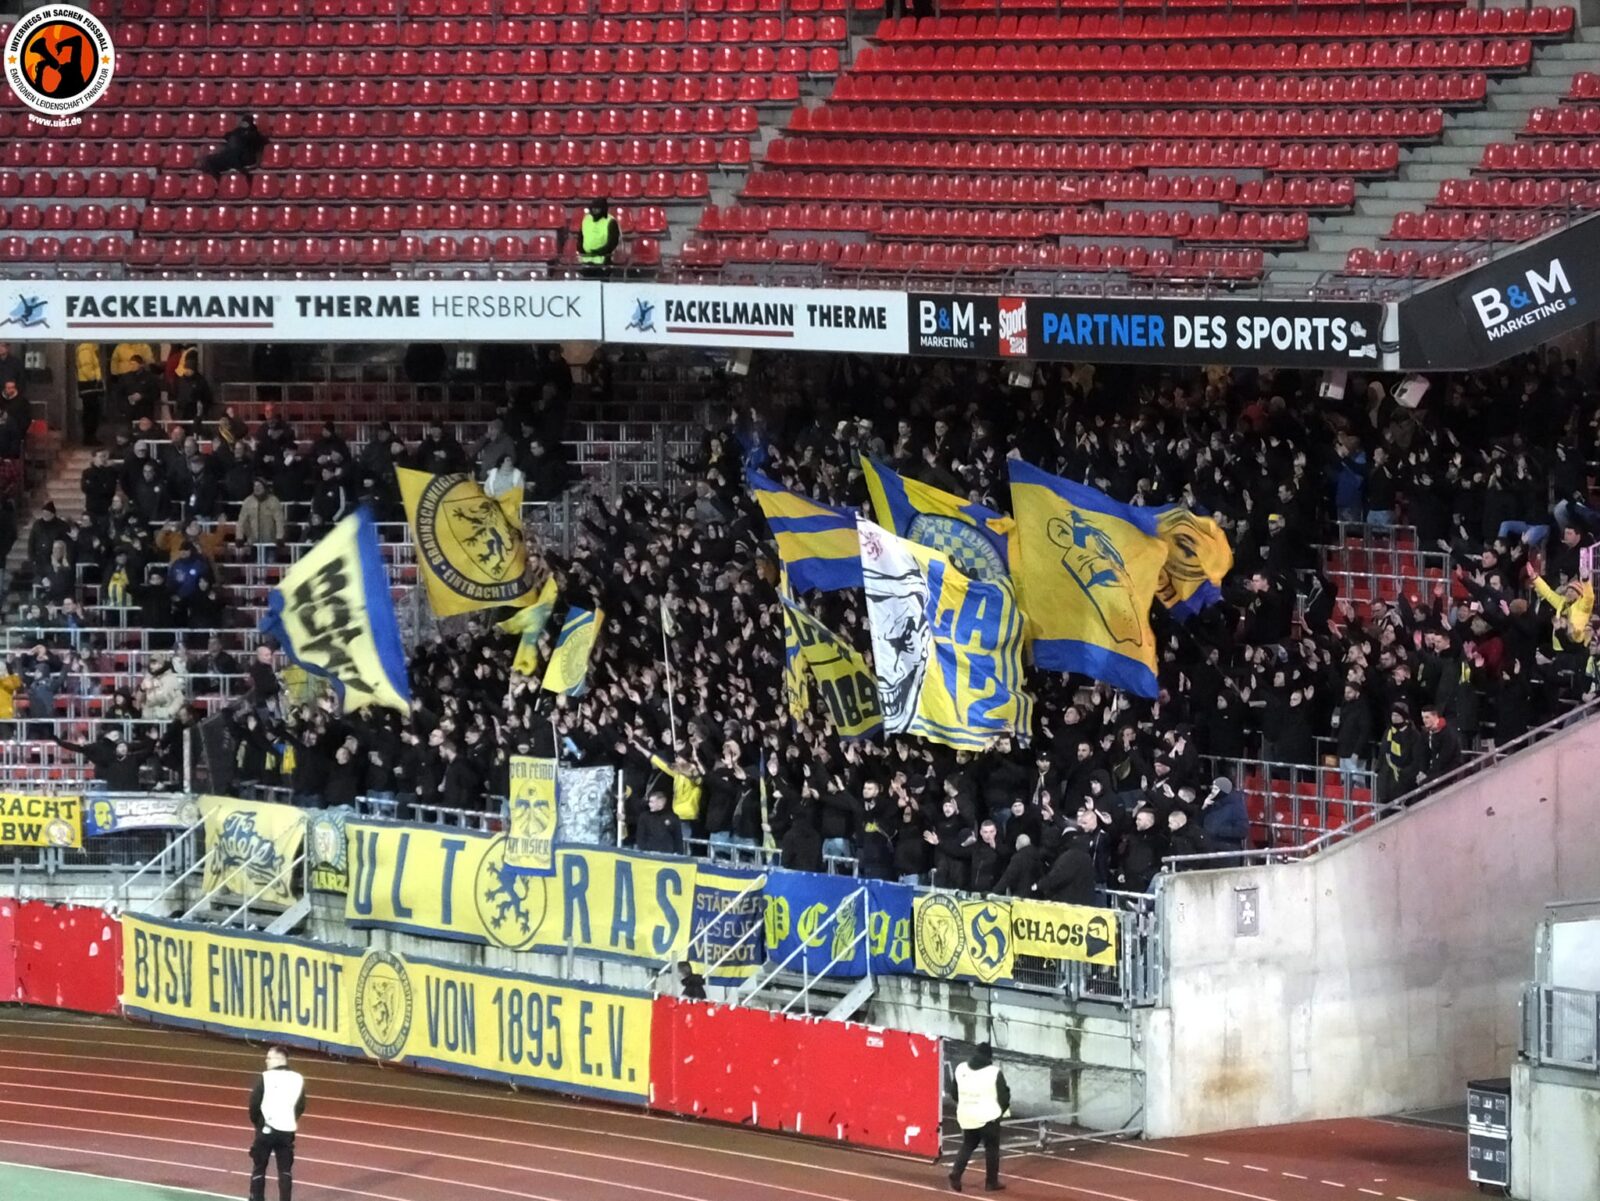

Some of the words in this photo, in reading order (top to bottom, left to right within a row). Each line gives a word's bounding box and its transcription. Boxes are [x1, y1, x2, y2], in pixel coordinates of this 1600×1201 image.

[66, 295, 275, 318] FACKELMANN
[296, 296, 420, 318] THERME
[432, 295, 582, 318] HERSBRUCK
[1472, 258, 1572, 329] B&M
[665, 300, 794, 326] FACKELMANN
[807, 305, 887, 330] THERME
[919, 300, 975, 336] B&M
[999, 302, 1027, 340] Sport
[1486, 299, 1566, 341] MARKETING
[920, 336, 968, 348] MARKETING
[1043, 313, 1165, 346] PARTNER
[1174, 316, 1226, 350] DES
[1237, 317, 1347, 351] SPORTS
[442, 568, 505, 599] EINTRACHT
[1, 822, 42, 842] BW
[869, 909, 911, 964] 98
[1013, 917, 1084, 946] CHAOS
[694, 940, 756, 961] VERBOT
[134, 928, 192, 1008] BTSV
[207, 943, 343, 1033] EINTRACHT
[425, 975, 476, 1056] VON
[491, 987, 563, 1070] 1895
[579, 1000, 636, 1082] E.V.
